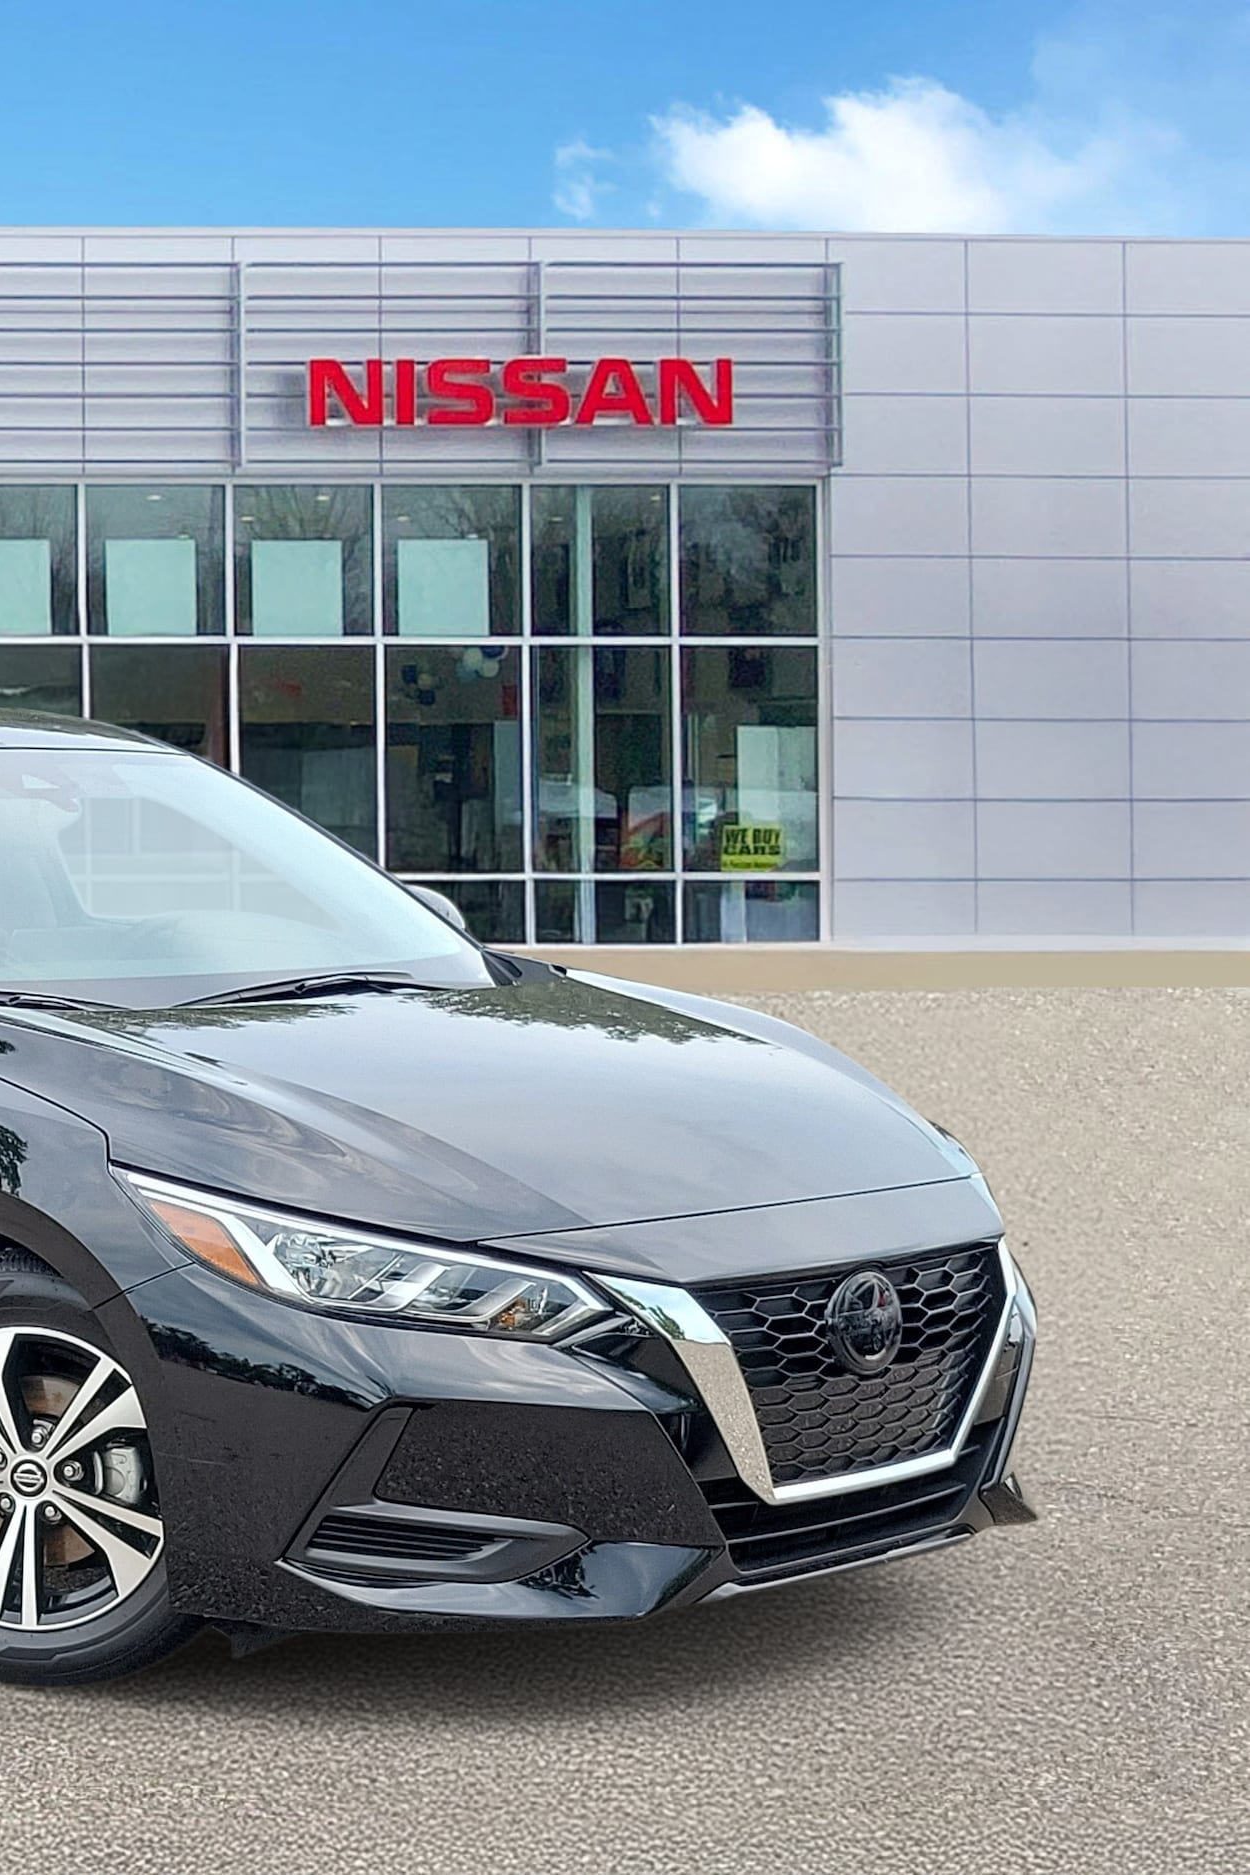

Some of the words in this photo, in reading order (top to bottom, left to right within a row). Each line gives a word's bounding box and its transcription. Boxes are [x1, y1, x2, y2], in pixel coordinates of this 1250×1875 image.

[308, 358, 733, 426] NISSAN
[725, 828, 748, 845] WE
[753, 828, 781, 845] BUY
[723, 844, 781, 856] CARS
